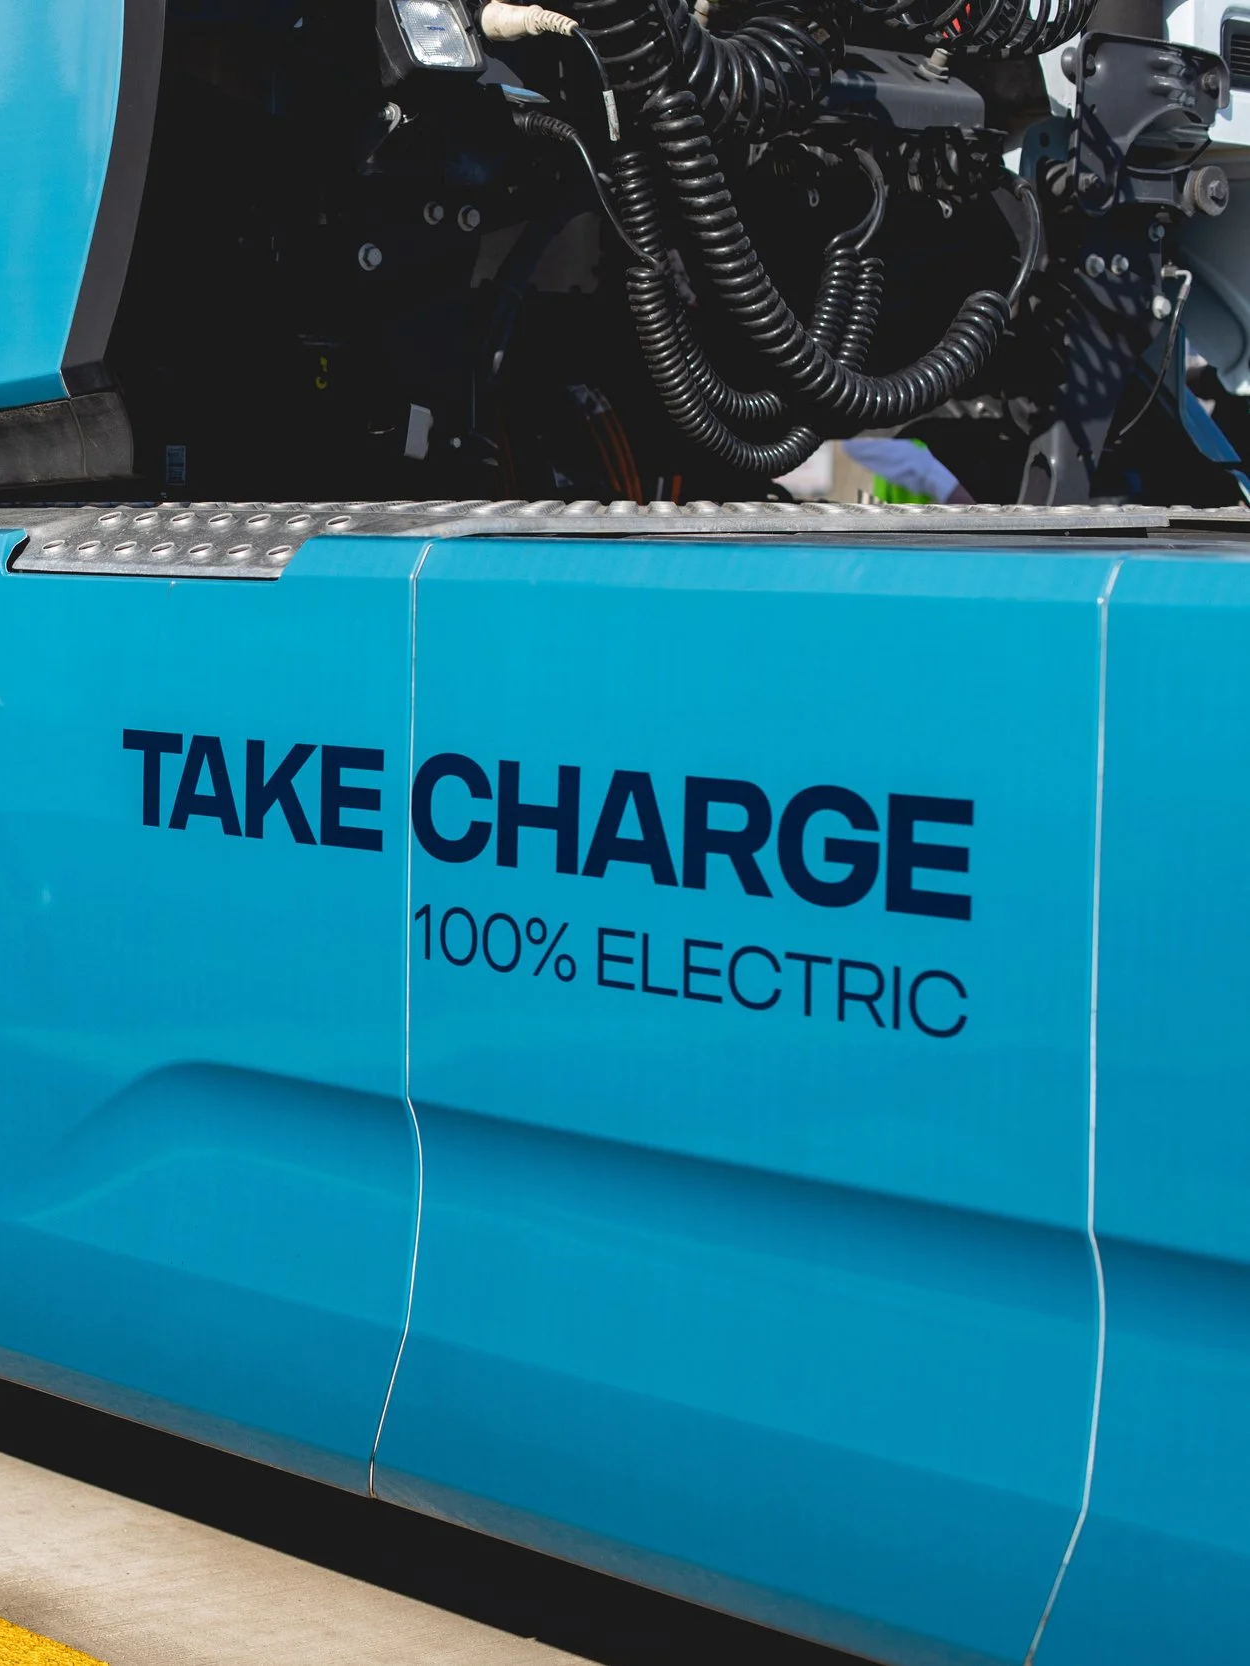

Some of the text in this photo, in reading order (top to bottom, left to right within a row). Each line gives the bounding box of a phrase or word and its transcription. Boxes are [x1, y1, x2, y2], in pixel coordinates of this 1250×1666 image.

[122, 728, 974, 922] TAKE CHARGE
[413, 903, 968, 1039] 100% ELECTRIC
